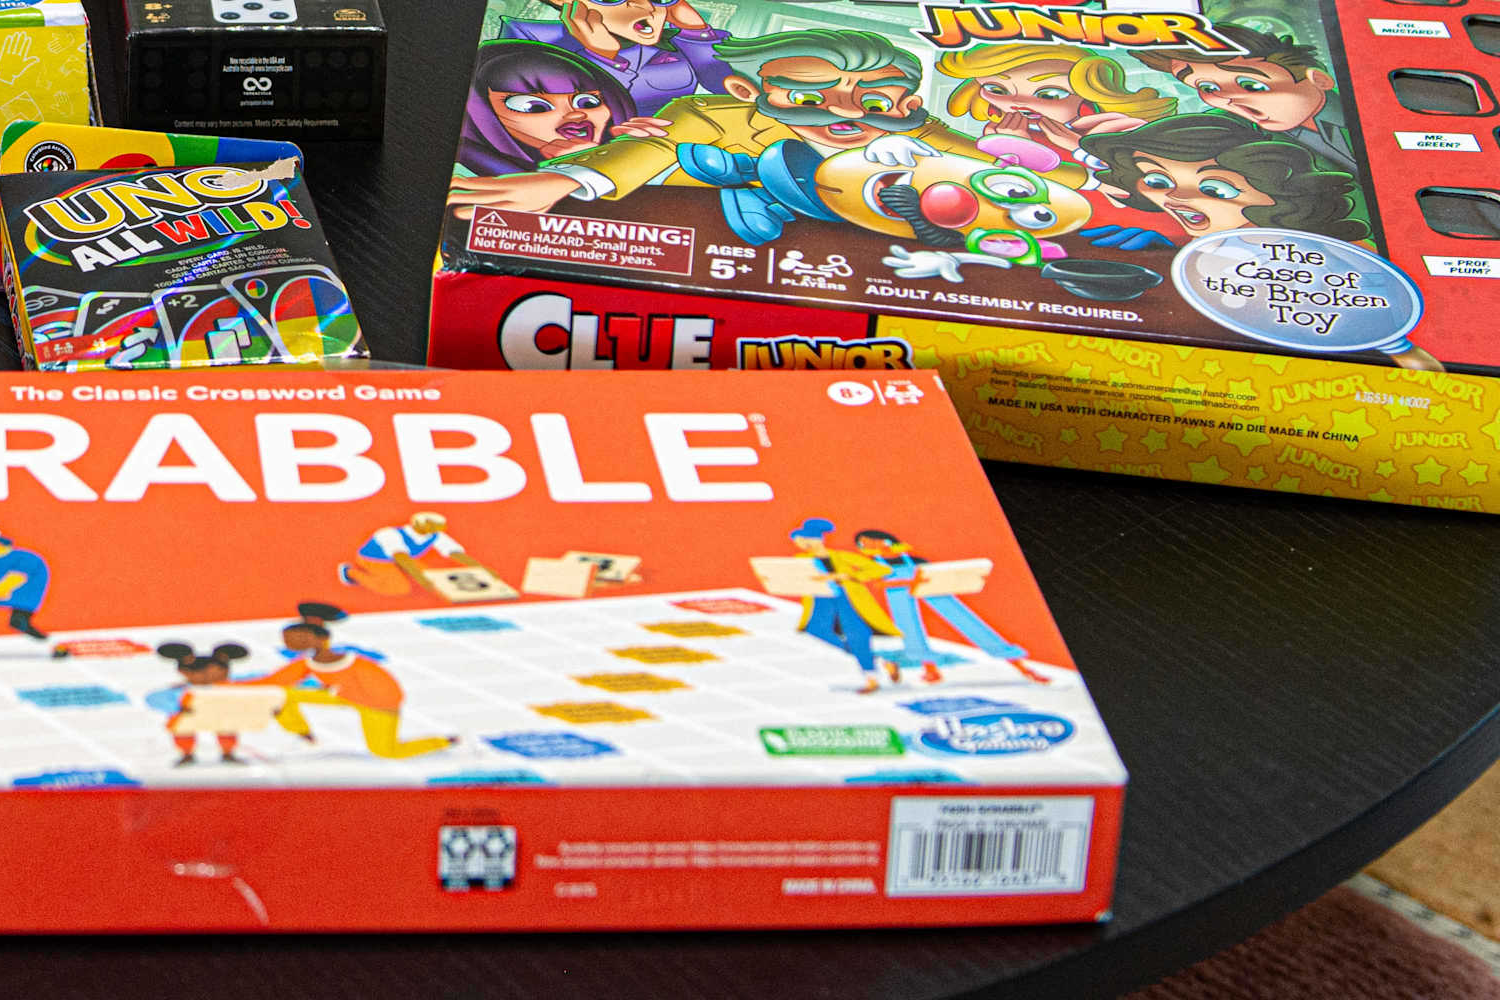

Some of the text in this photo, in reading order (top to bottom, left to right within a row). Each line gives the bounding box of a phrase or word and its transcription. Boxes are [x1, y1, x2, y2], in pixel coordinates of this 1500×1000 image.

[929, 5, 1240, 51] JUNIOR
[1416, 141, 1461, 149] GREEN?
[23, 166, 268, 243] UNO
[154, 199, 313, 246] WILD!
[538, 215, 691, 247] WARNING:
[70, 228, 164, 273] ALL
[474, 225, 533, 243] CHOKING
[628, 243, 666, 258] parts.
[474, 236, 657, 267] Not for children under 3 years.
[704, 243, 757, 260] AGES
[1261, 242, 1326, 267] The
[708, 258, 754, 281] 5+
[780, 276, 849, 292] PLAYERS
[1235, 260, 1360, 290] Case of
[865, 284, 1145, 323] ADULT ASSEMBLY REQUIRED.
[1203, 275, 1388, 308] the Broken
[499, 292, 716, 370] CLUE
[1268, 303, 1340, 335] Toy
[991, 367, 1030, 379] Australia
[10, 384, 442, 401] The Classic Crossword Game
[1269, 372, 1371, 413] JUNIOR
[987, 397, 1361, 445] MADE IN USA WITH CHARACTER PAWNS AND DIE MADE IN CHINA
[934, 714, 1067, 741] Hasbro
